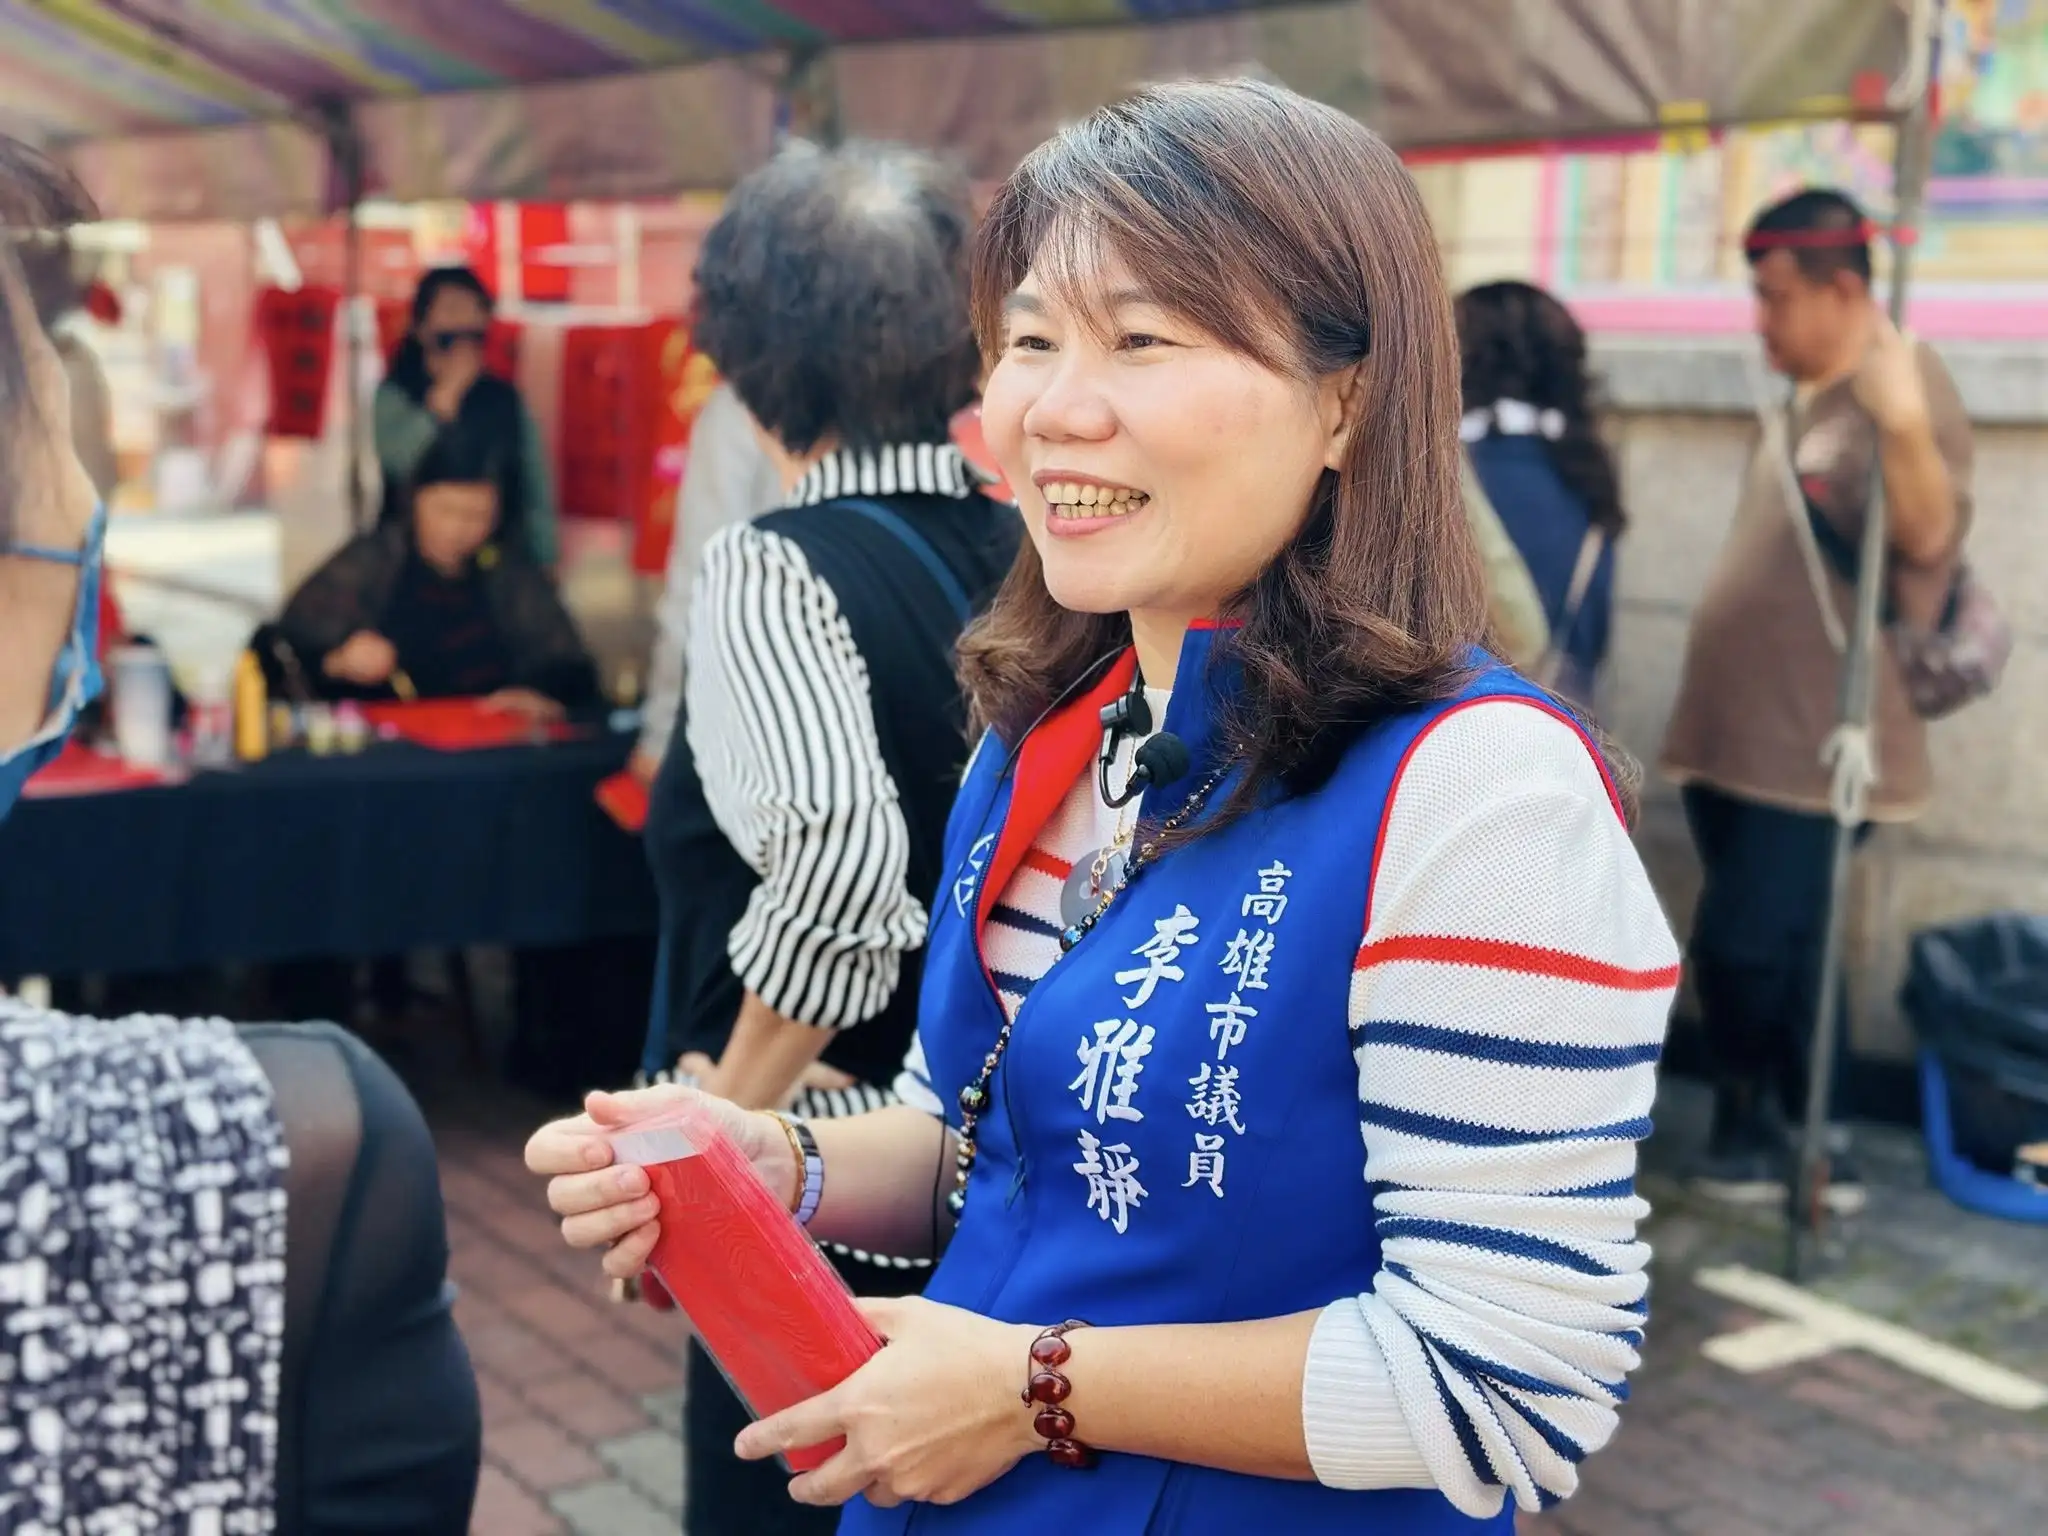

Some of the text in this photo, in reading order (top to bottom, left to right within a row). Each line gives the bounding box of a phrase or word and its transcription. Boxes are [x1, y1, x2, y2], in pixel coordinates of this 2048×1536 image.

[1068, 903, 1200, 1235] 李雅靜
[1181, 859, 1293, 1199] 高雄市議員
